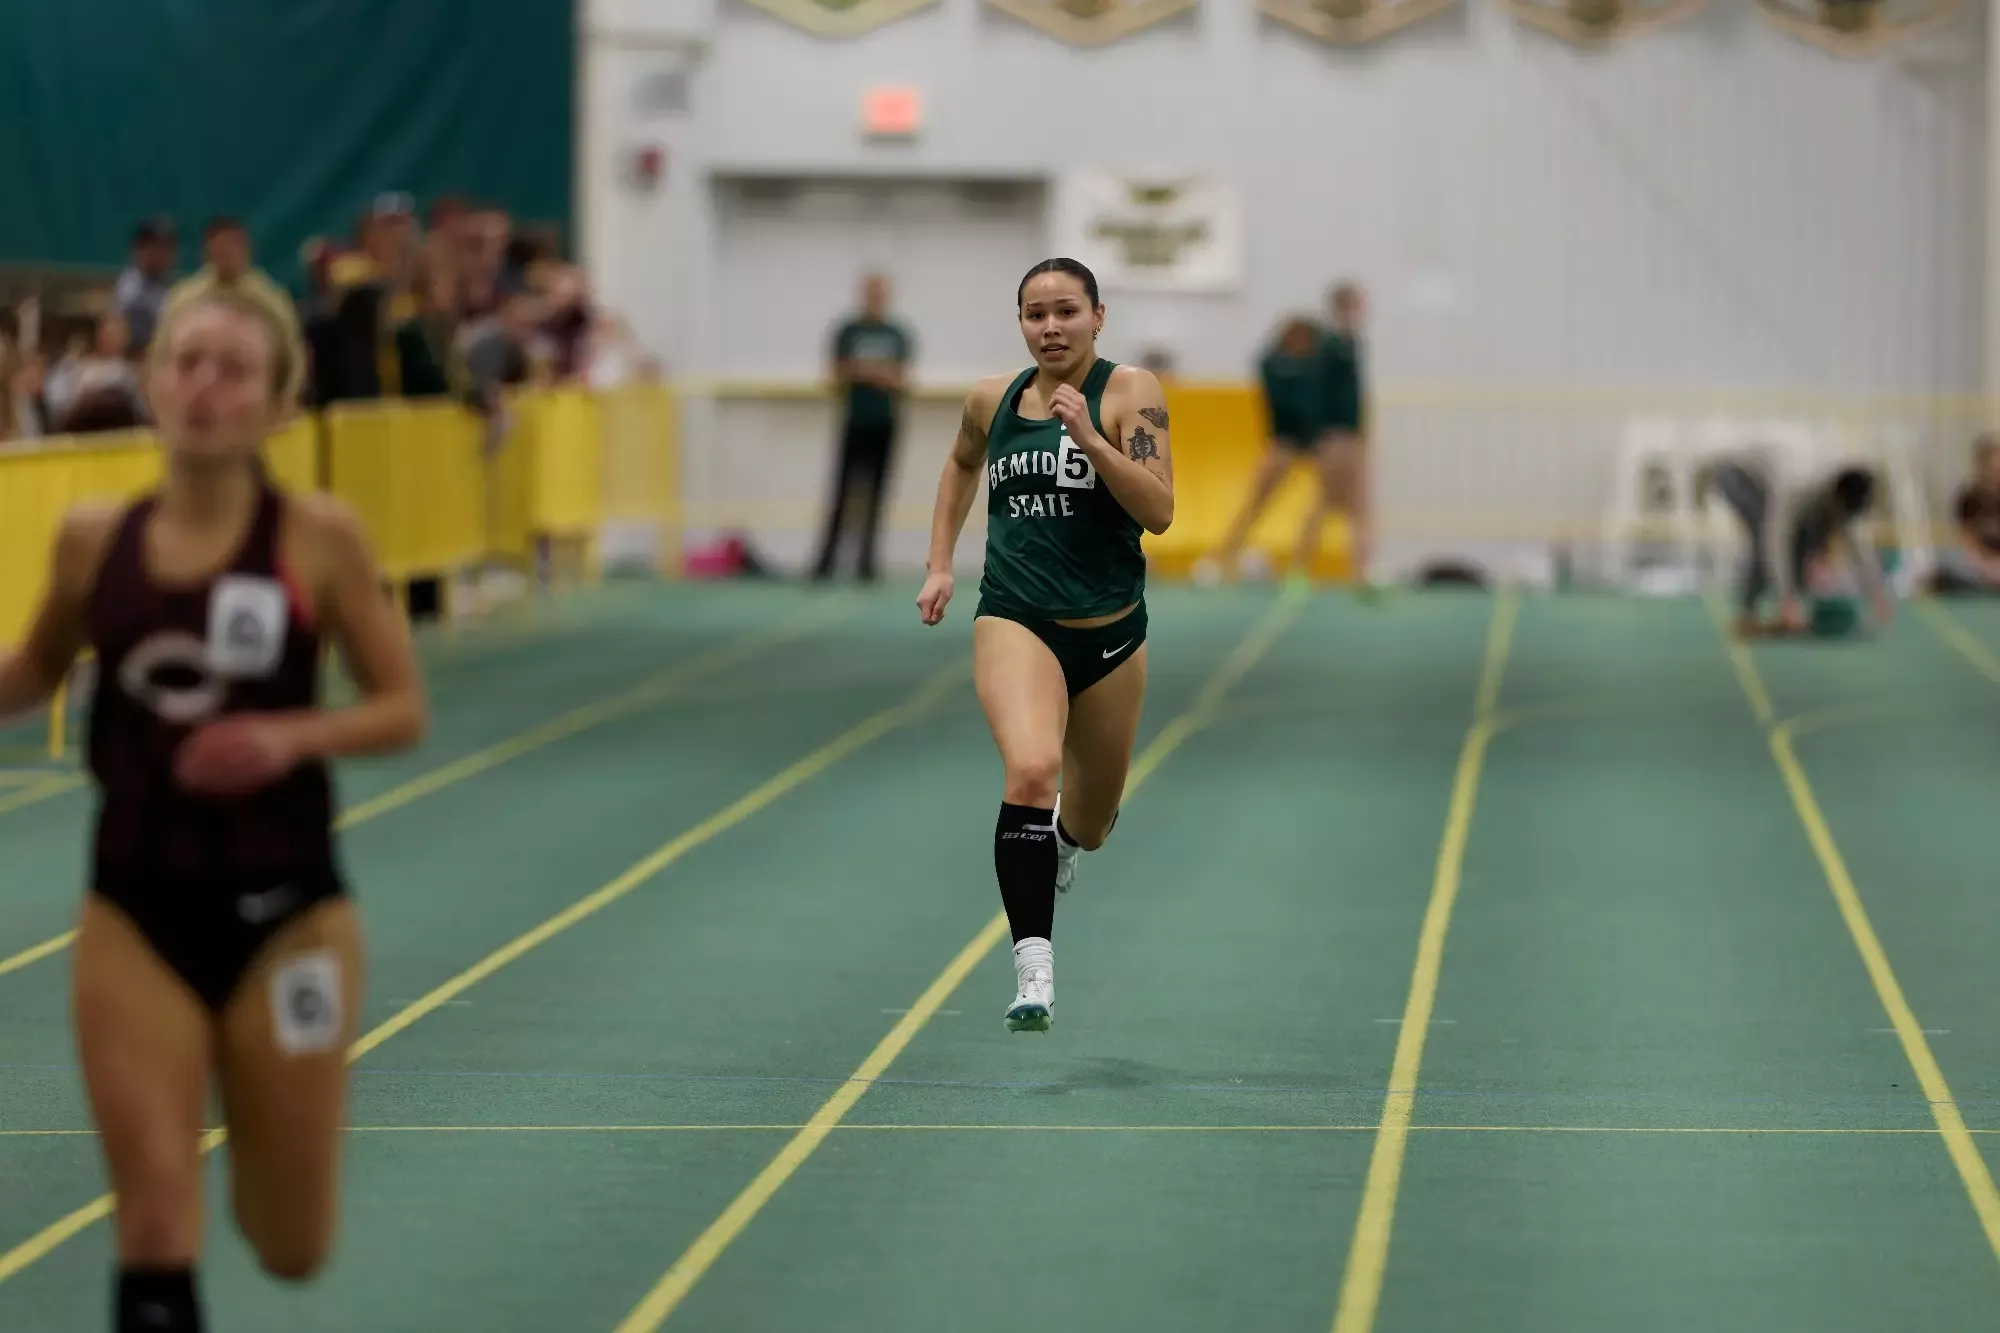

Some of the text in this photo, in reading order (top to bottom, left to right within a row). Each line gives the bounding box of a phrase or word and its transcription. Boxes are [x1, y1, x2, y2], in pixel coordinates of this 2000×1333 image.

[989, 451, 1057, 490] BEMID
[1065, 447, 1089, 480] 5
[1008, 493, 1074, 518] STATE
